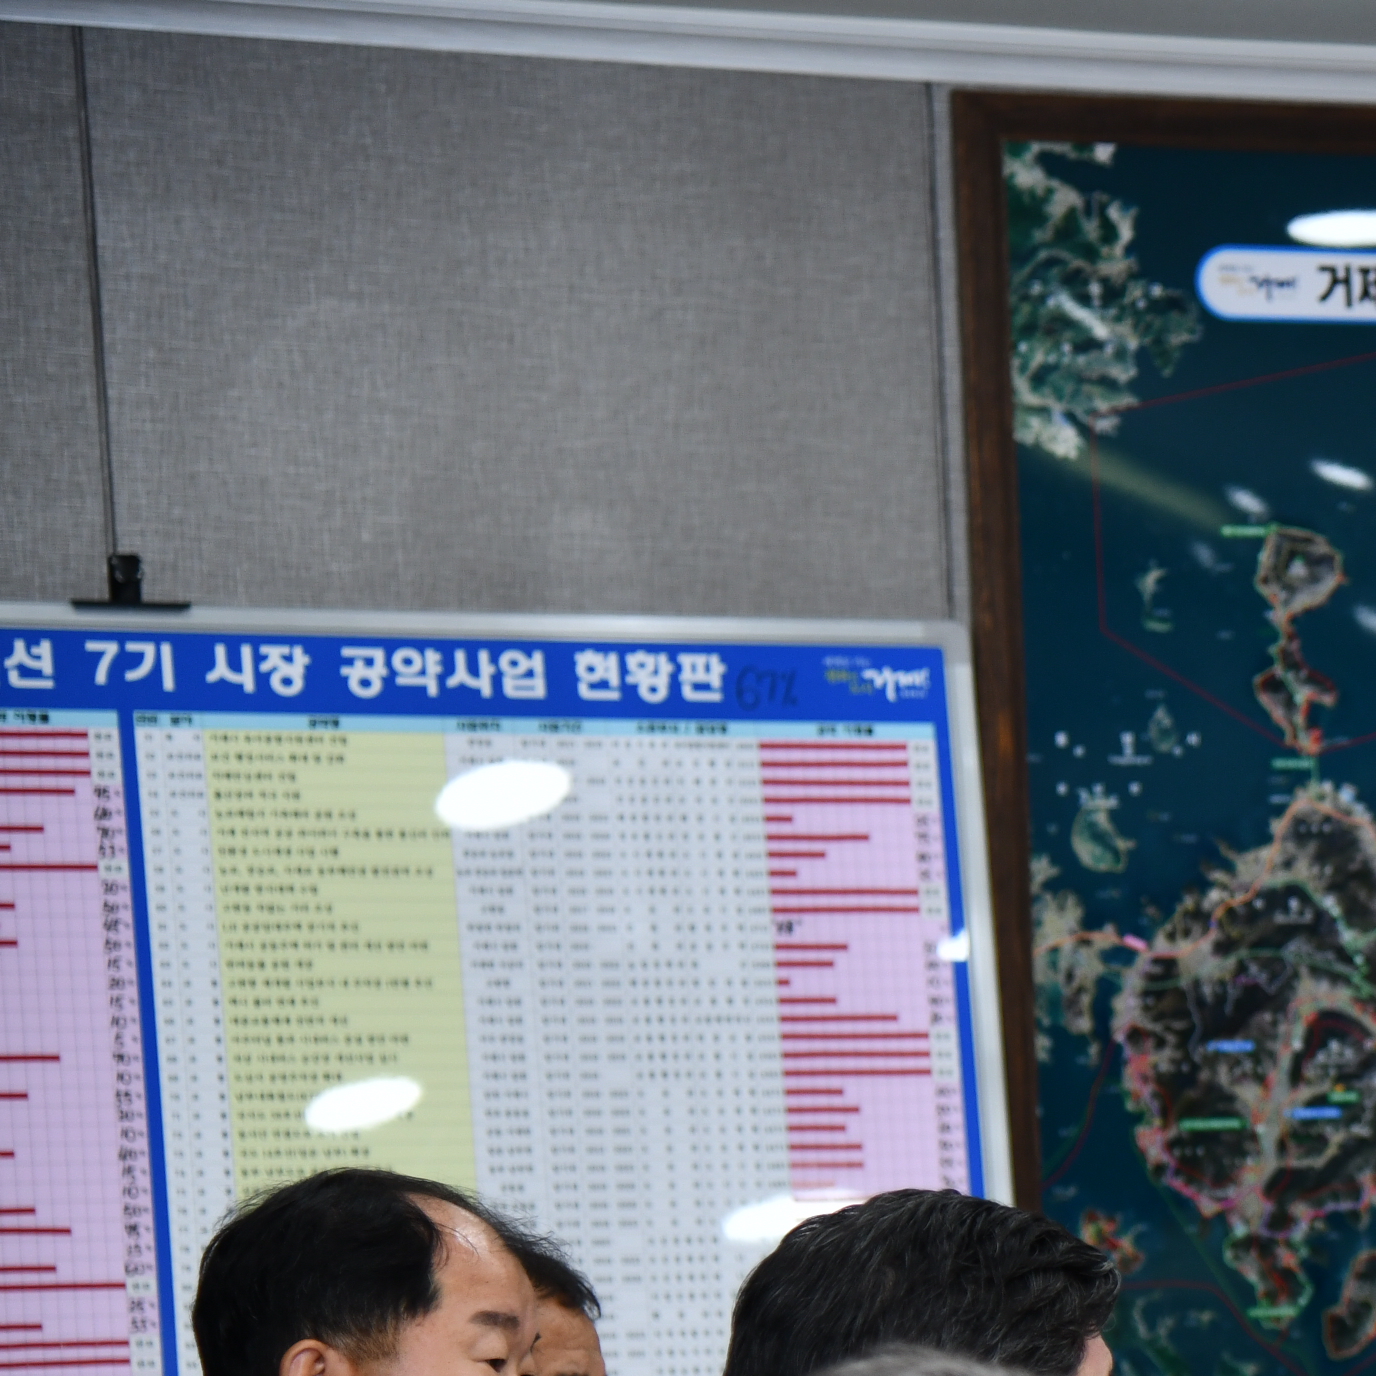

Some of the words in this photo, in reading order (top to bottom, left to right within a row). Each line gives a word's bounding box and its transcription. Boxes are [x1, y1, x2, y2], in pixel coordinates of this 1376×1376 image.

[84, 641, 175, 692] 7기
[206, 643, 311, 697] 시장
[339, 646, 547, 700] 공약사업
[574, 649, 726, 703] 현황판
